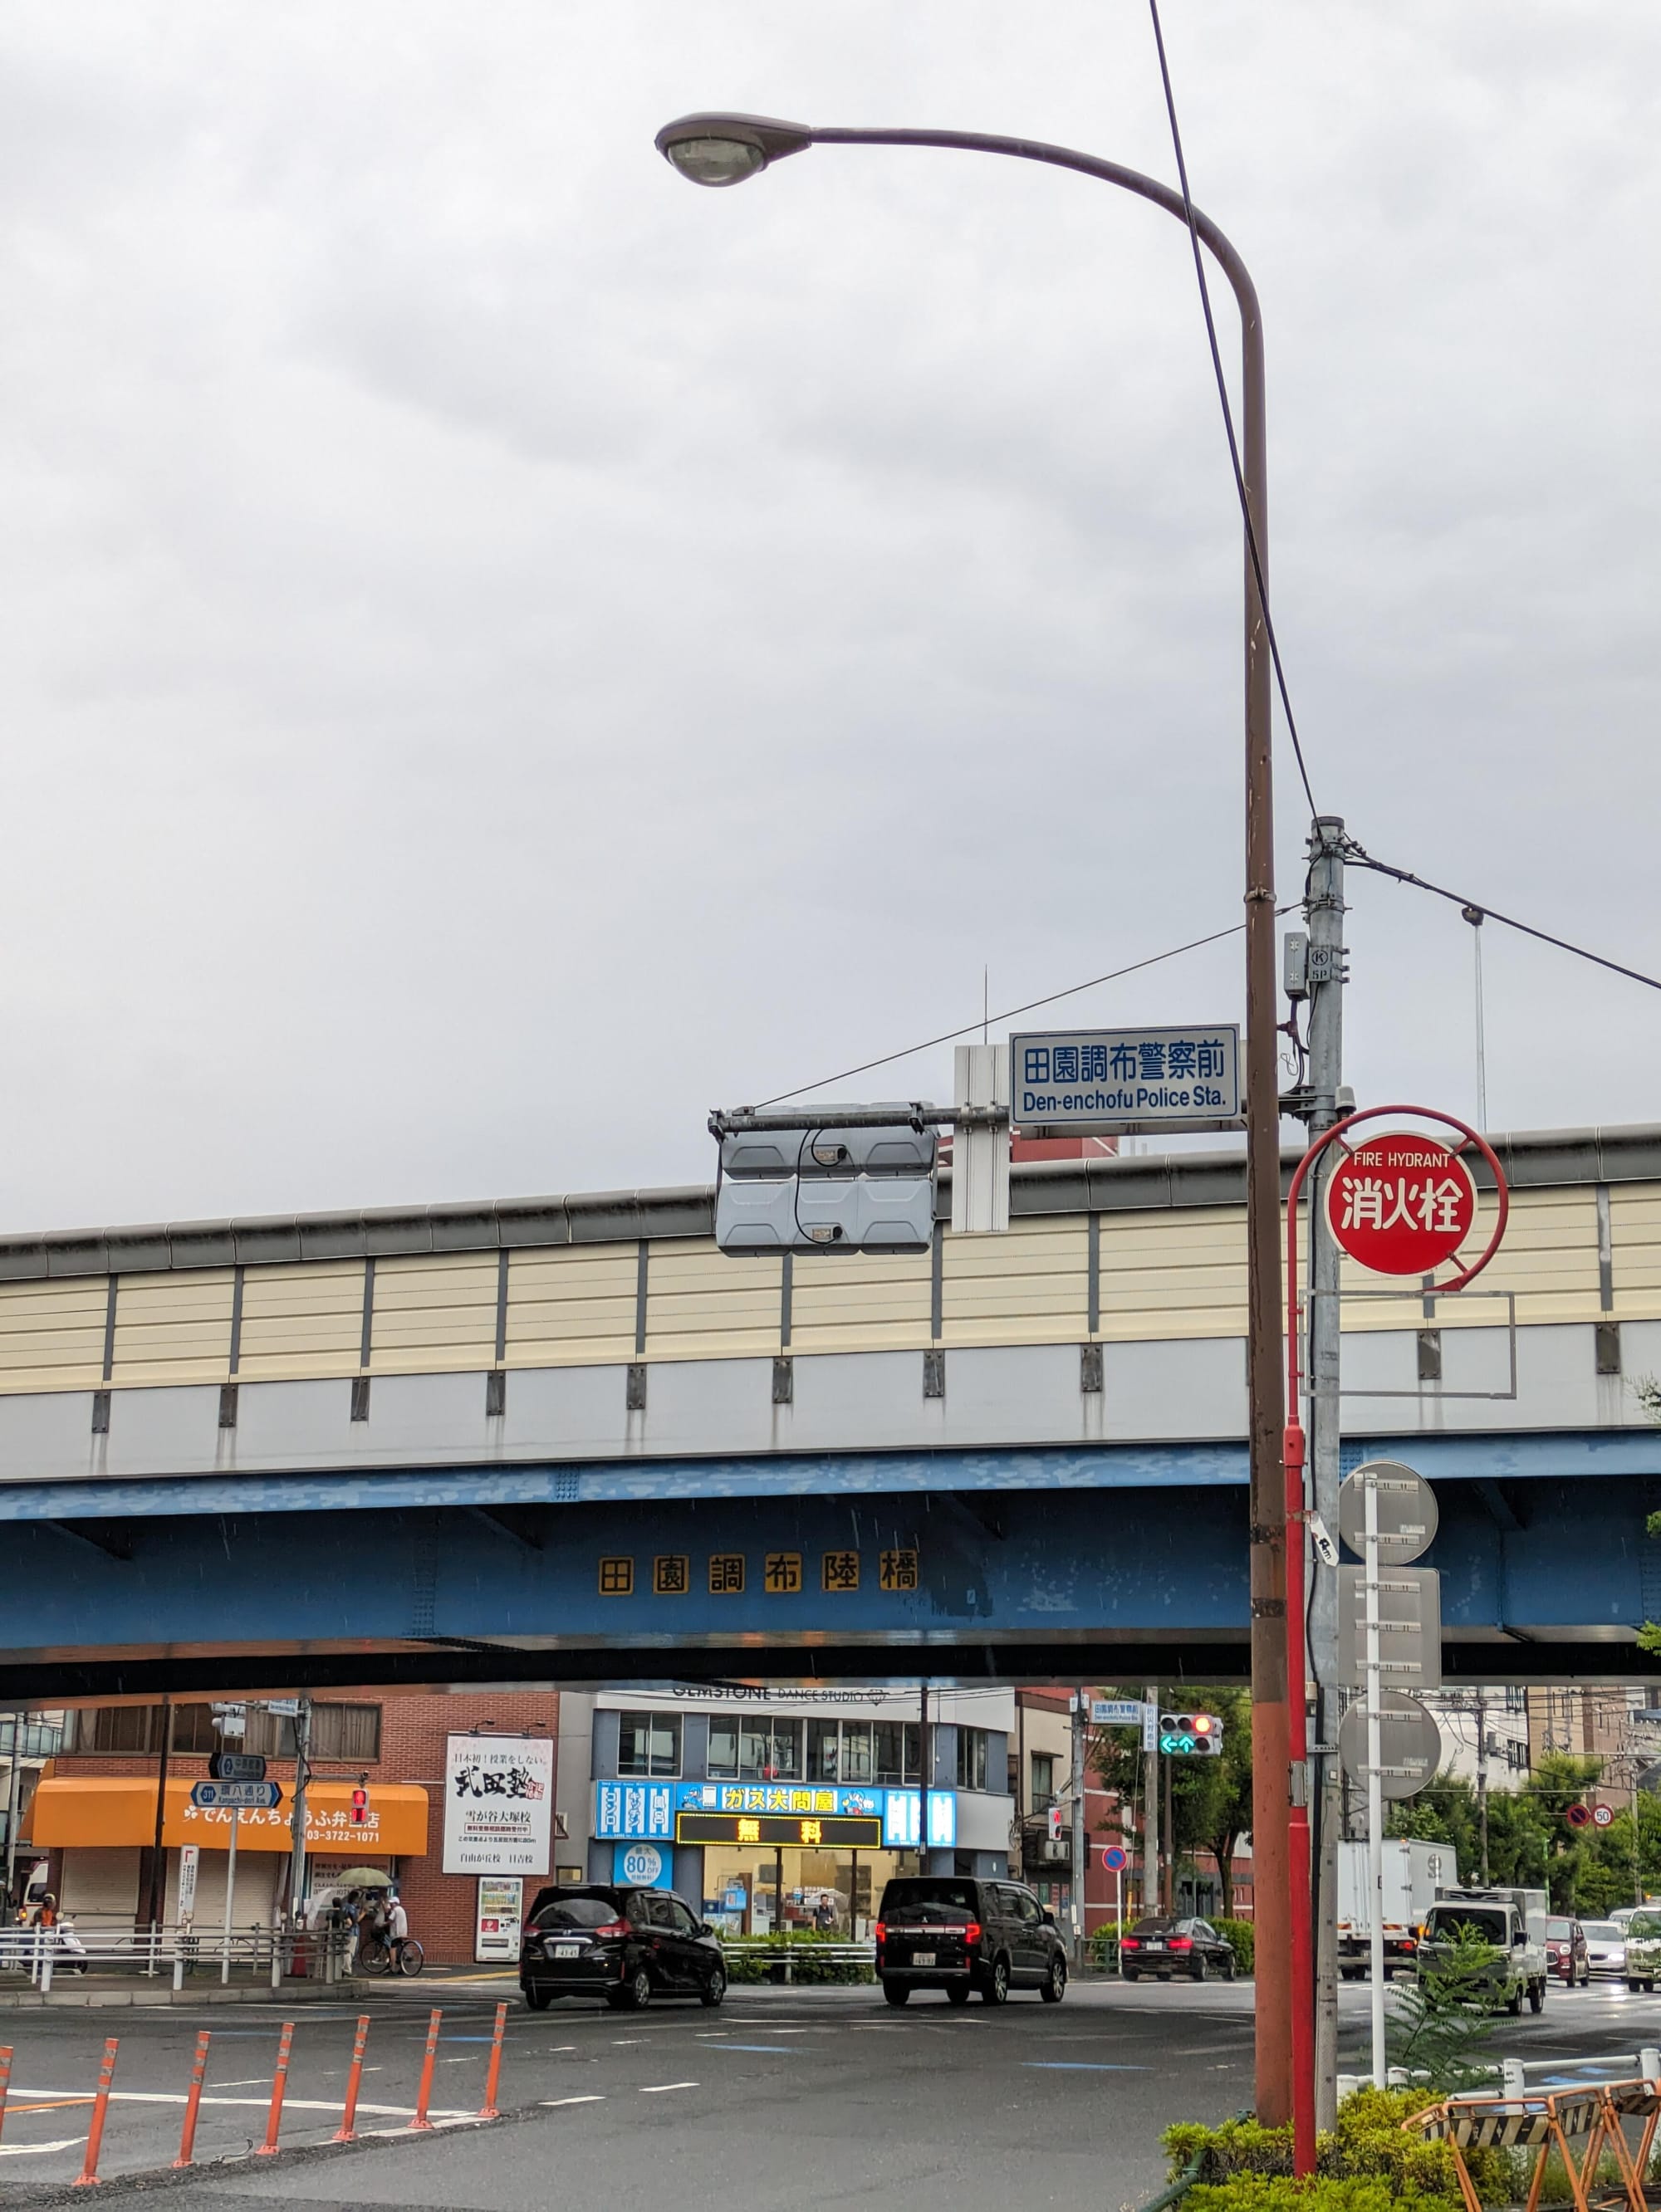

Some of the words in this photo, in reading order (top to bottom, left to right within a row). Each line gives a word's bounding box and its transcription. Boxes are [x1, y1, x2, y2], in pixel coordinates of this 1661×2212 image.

[1024, 1039, 1225, 1084] 田園調布警察前
[1023, 1089, 1134, 1112] Den-enchofu
[1137, 1087, 1189, 1108] Police
[1193, 1085, 1227, 1106] Sta.
[1354, 1152, 1383, 1167] FIRE
[1388, 1152, 1451, 1167] HYDRANT
[1341, 1177, 1464, 1232] 消火栓
[600, 1552, 916, 1593] 田園調布陸橋
[777, 1687, 818, 1701] DANCE
[821, 1691, 864, 1702] STUDIO
[203, 1789, 214, 1801] 311
[725, 1789, 835, 1812] ガス大問屋
[605, 1792, 616, 1826] コンロ
[1596, 1811, 1610, 1821] 50
[306, 1830, 380, 1843] 03-3722-1071
